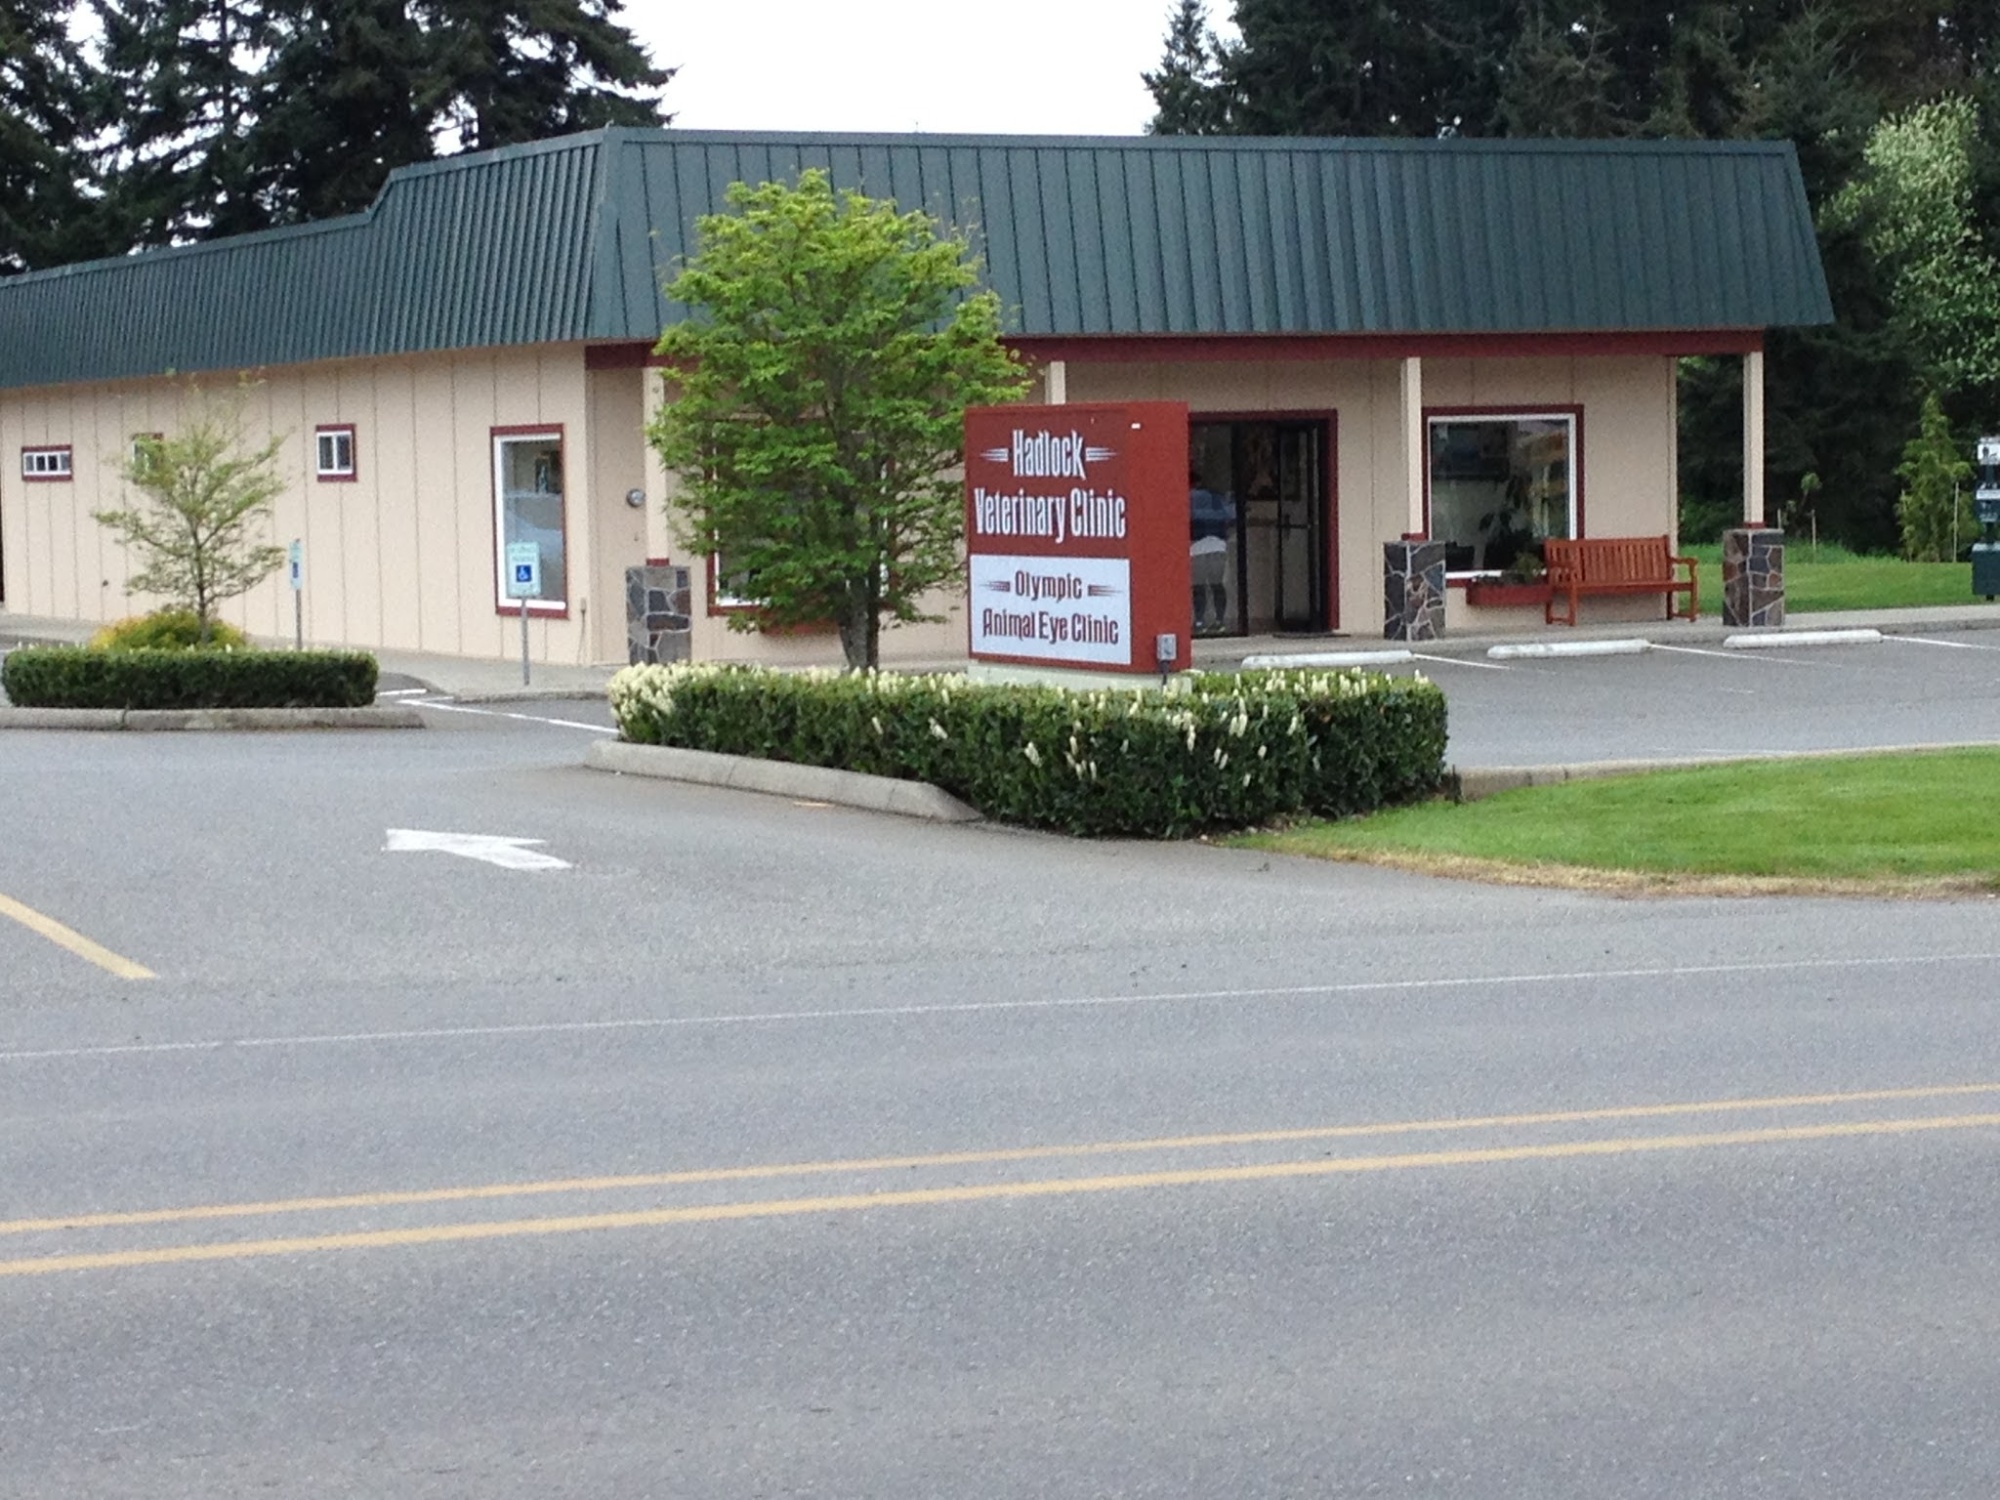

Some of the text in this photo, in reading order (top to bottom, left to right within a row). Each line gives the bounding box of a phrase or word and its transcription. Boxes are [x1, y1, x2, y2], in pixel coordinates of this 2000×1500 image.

[1013, 429, 1086, 480] Hadlock
[974, 487, 1126, 544] Veterinary Clinic
[1015, 570, 1082, 603] Olympic
[983, 608, 1119, 646] Animal Eye Clinic
